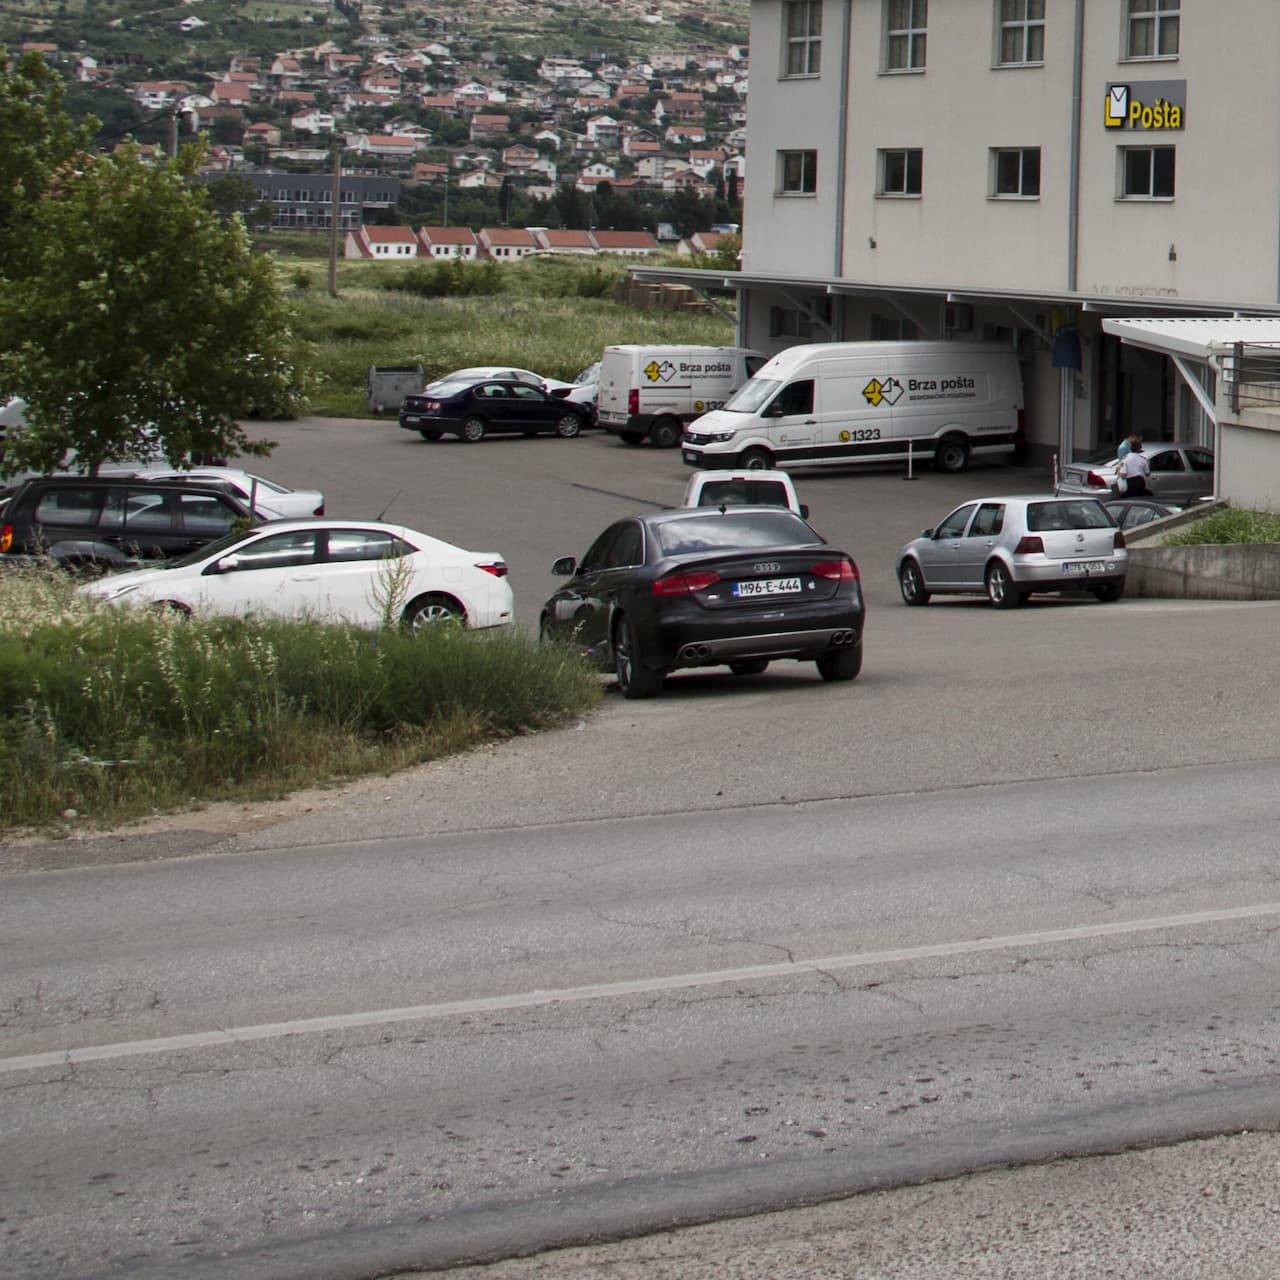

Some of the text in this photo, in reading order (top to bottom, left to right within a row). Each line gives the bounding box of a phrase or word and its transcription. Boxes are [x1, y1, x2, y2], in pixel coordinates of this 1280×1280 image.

[1129, 97, 1181, 128] Pošta
[680, 361, 731, 373] Brza pošta
[908, 377, 975, 392] Brza pošta
[851, 429, 881, 441] 1323
[740, 580, 799, 594] M96-E-444
